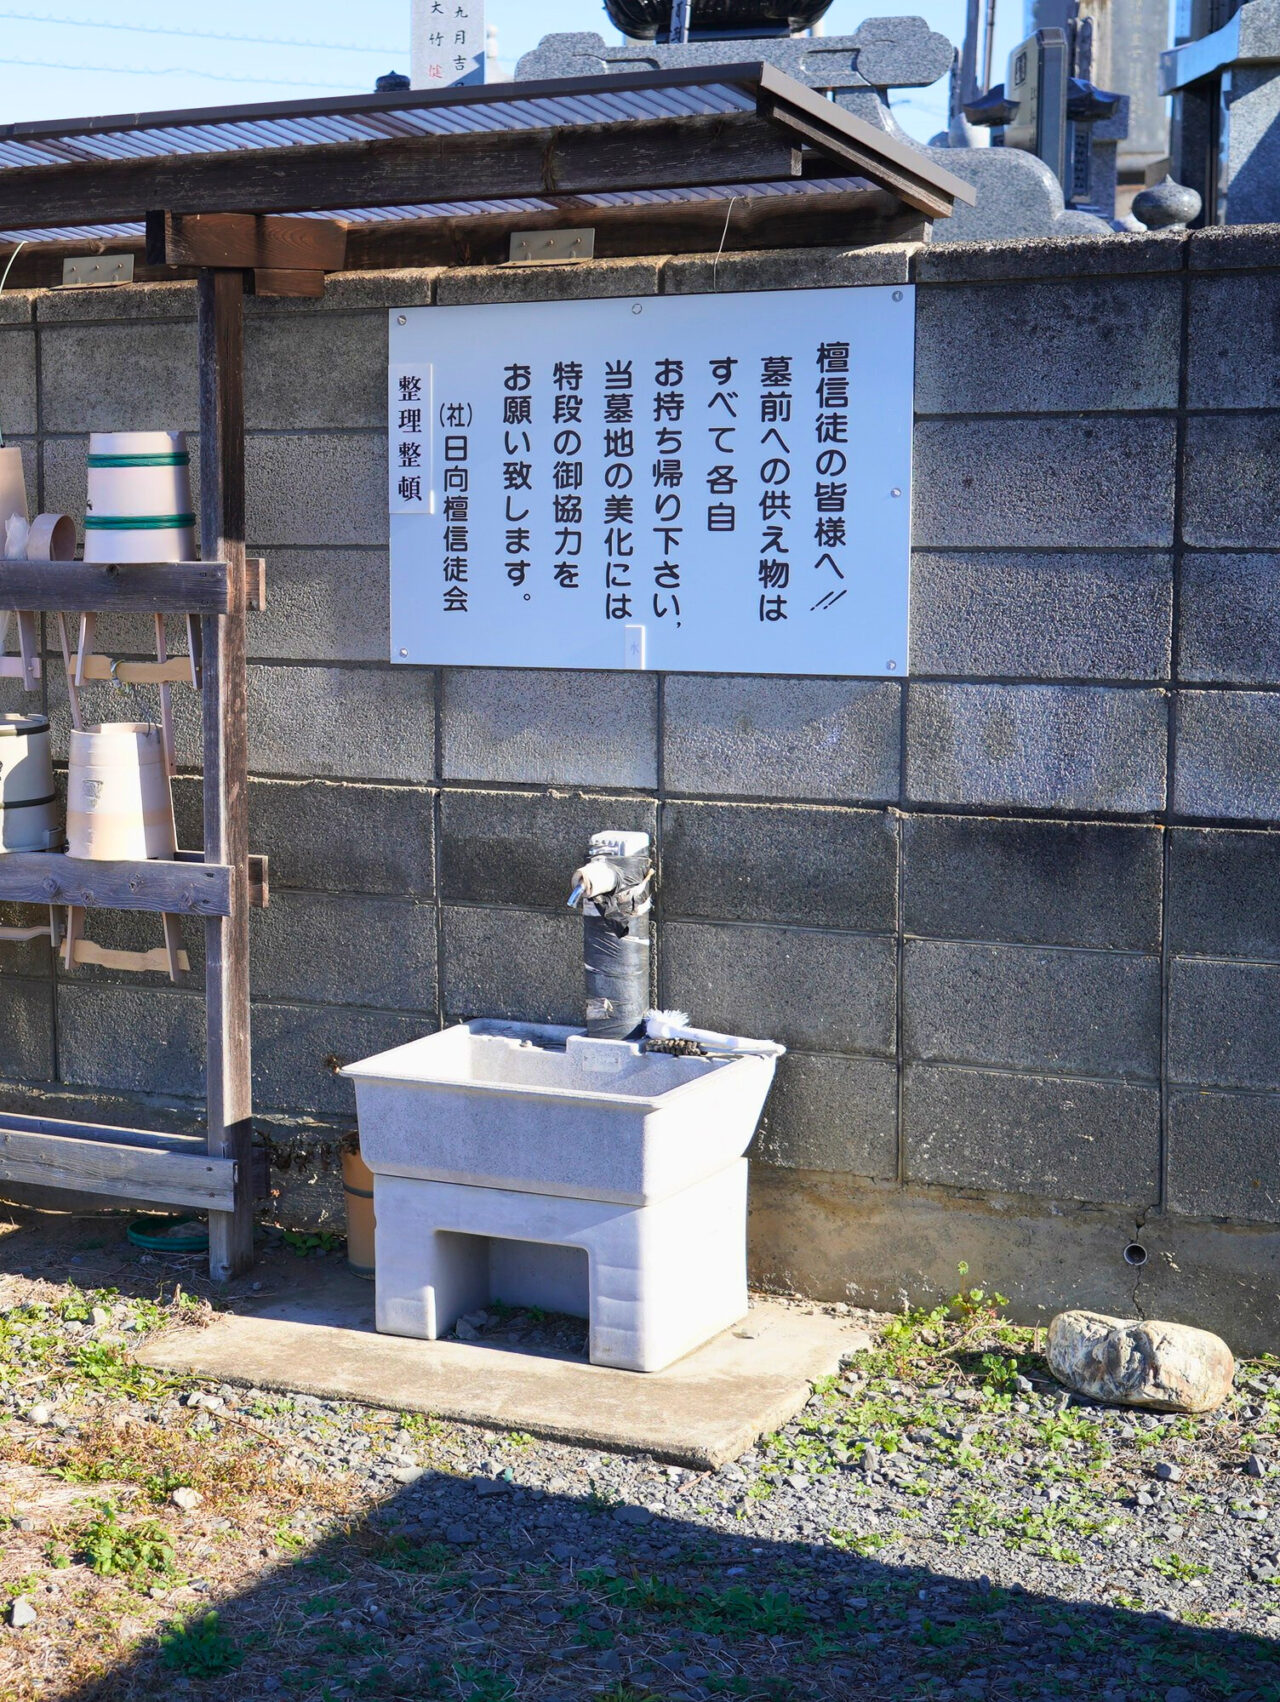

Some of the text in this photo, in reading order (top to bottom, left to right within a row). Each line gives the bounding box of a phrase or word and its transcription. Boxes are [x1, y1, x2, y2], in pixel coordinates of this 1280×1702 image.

[397, 375, 423, 502] 整理整頓
[439, 402, 473, 613] (社)日向檀信徒会
[502, 362, 533, 602] お願い致します。
[552, 360, 585, 590] 特段の御協力を
[603, 359, 635, 620] 当墓地の美化には
[704, 355, 739, 532] すべて各自
[758, 355, 793, 622] 墓前への供え物は
